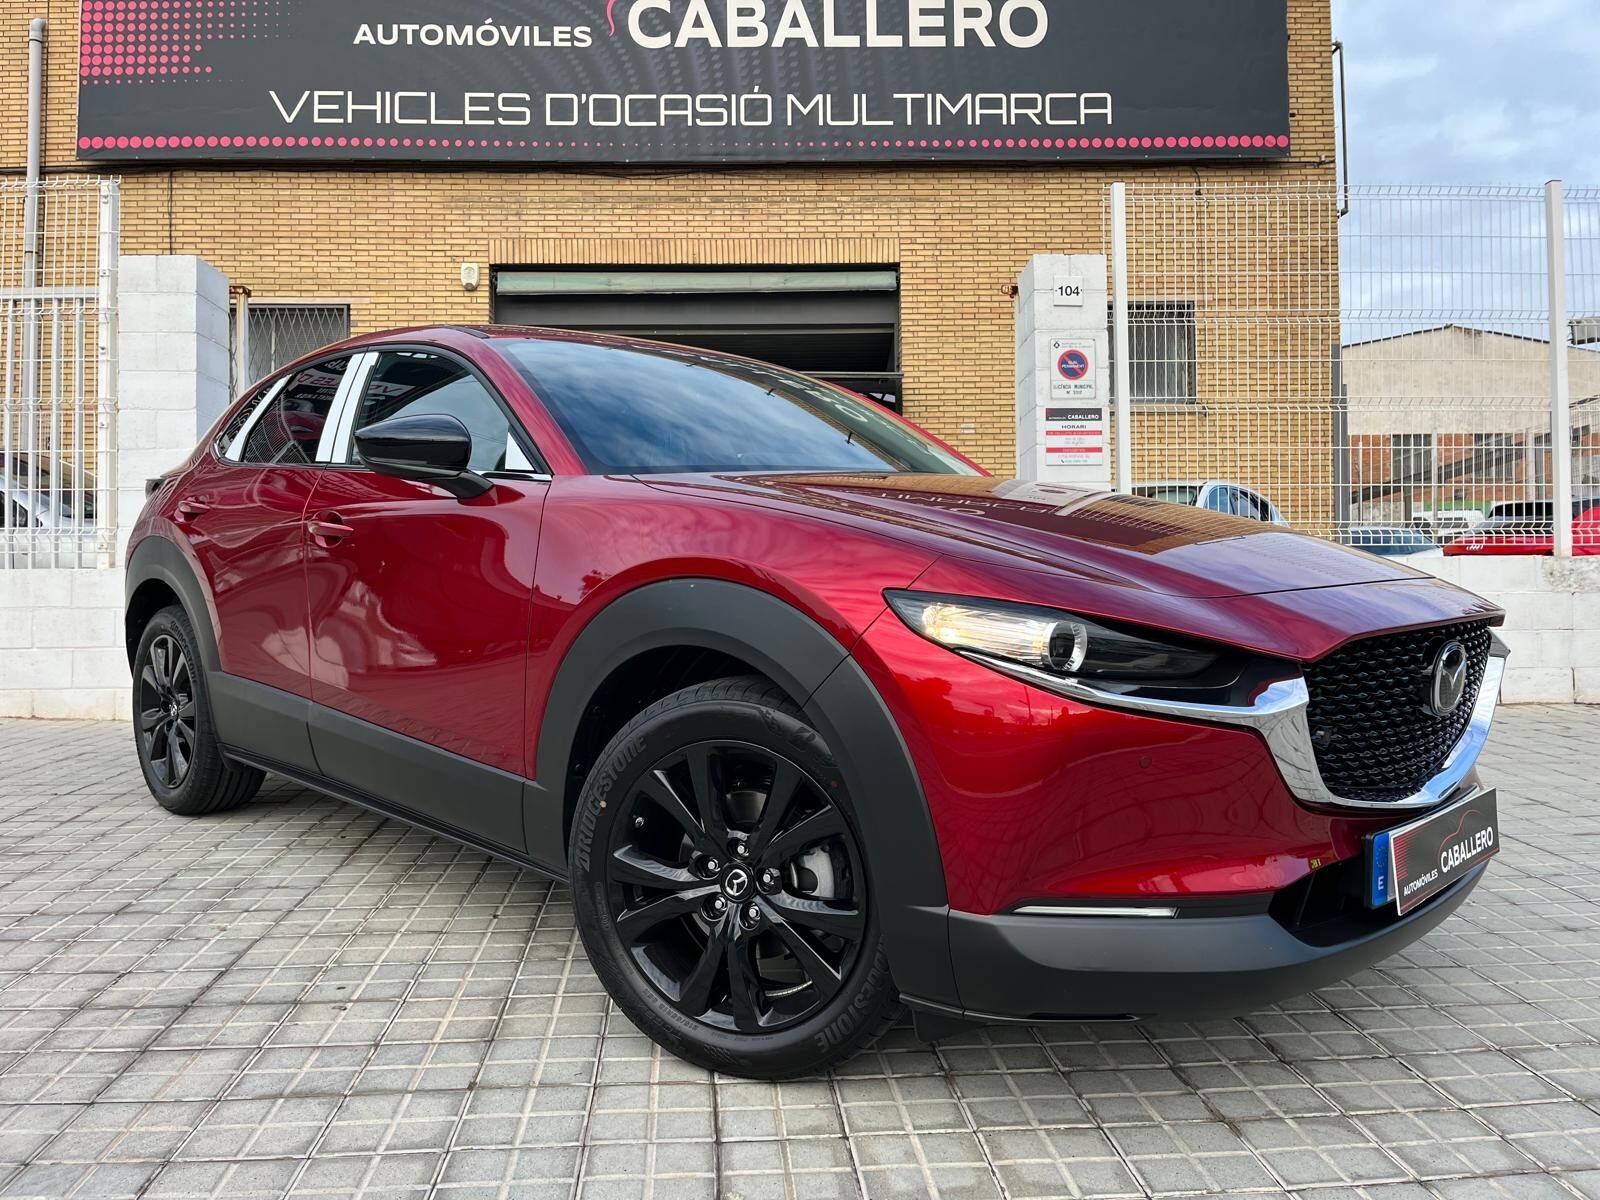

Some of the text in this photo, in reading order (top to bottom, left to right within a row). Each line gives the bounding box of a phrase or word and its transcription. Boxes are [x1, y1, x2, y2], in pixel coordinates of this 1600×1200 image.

[353, 0, 1049, 49] AUTOMÓVILES CABALLERO
[268, 85, 1113, 127] VEHICLES D'OCASIÓ MULTIMARCA
[1057, 285, 1080, 297] 104
[575, 737, 647, 873] BRIDGESTONE
[1377, 876, 1385, 891] E
[1403, 826, 1494, 897] AUTOMÓVILES CABALLERO
